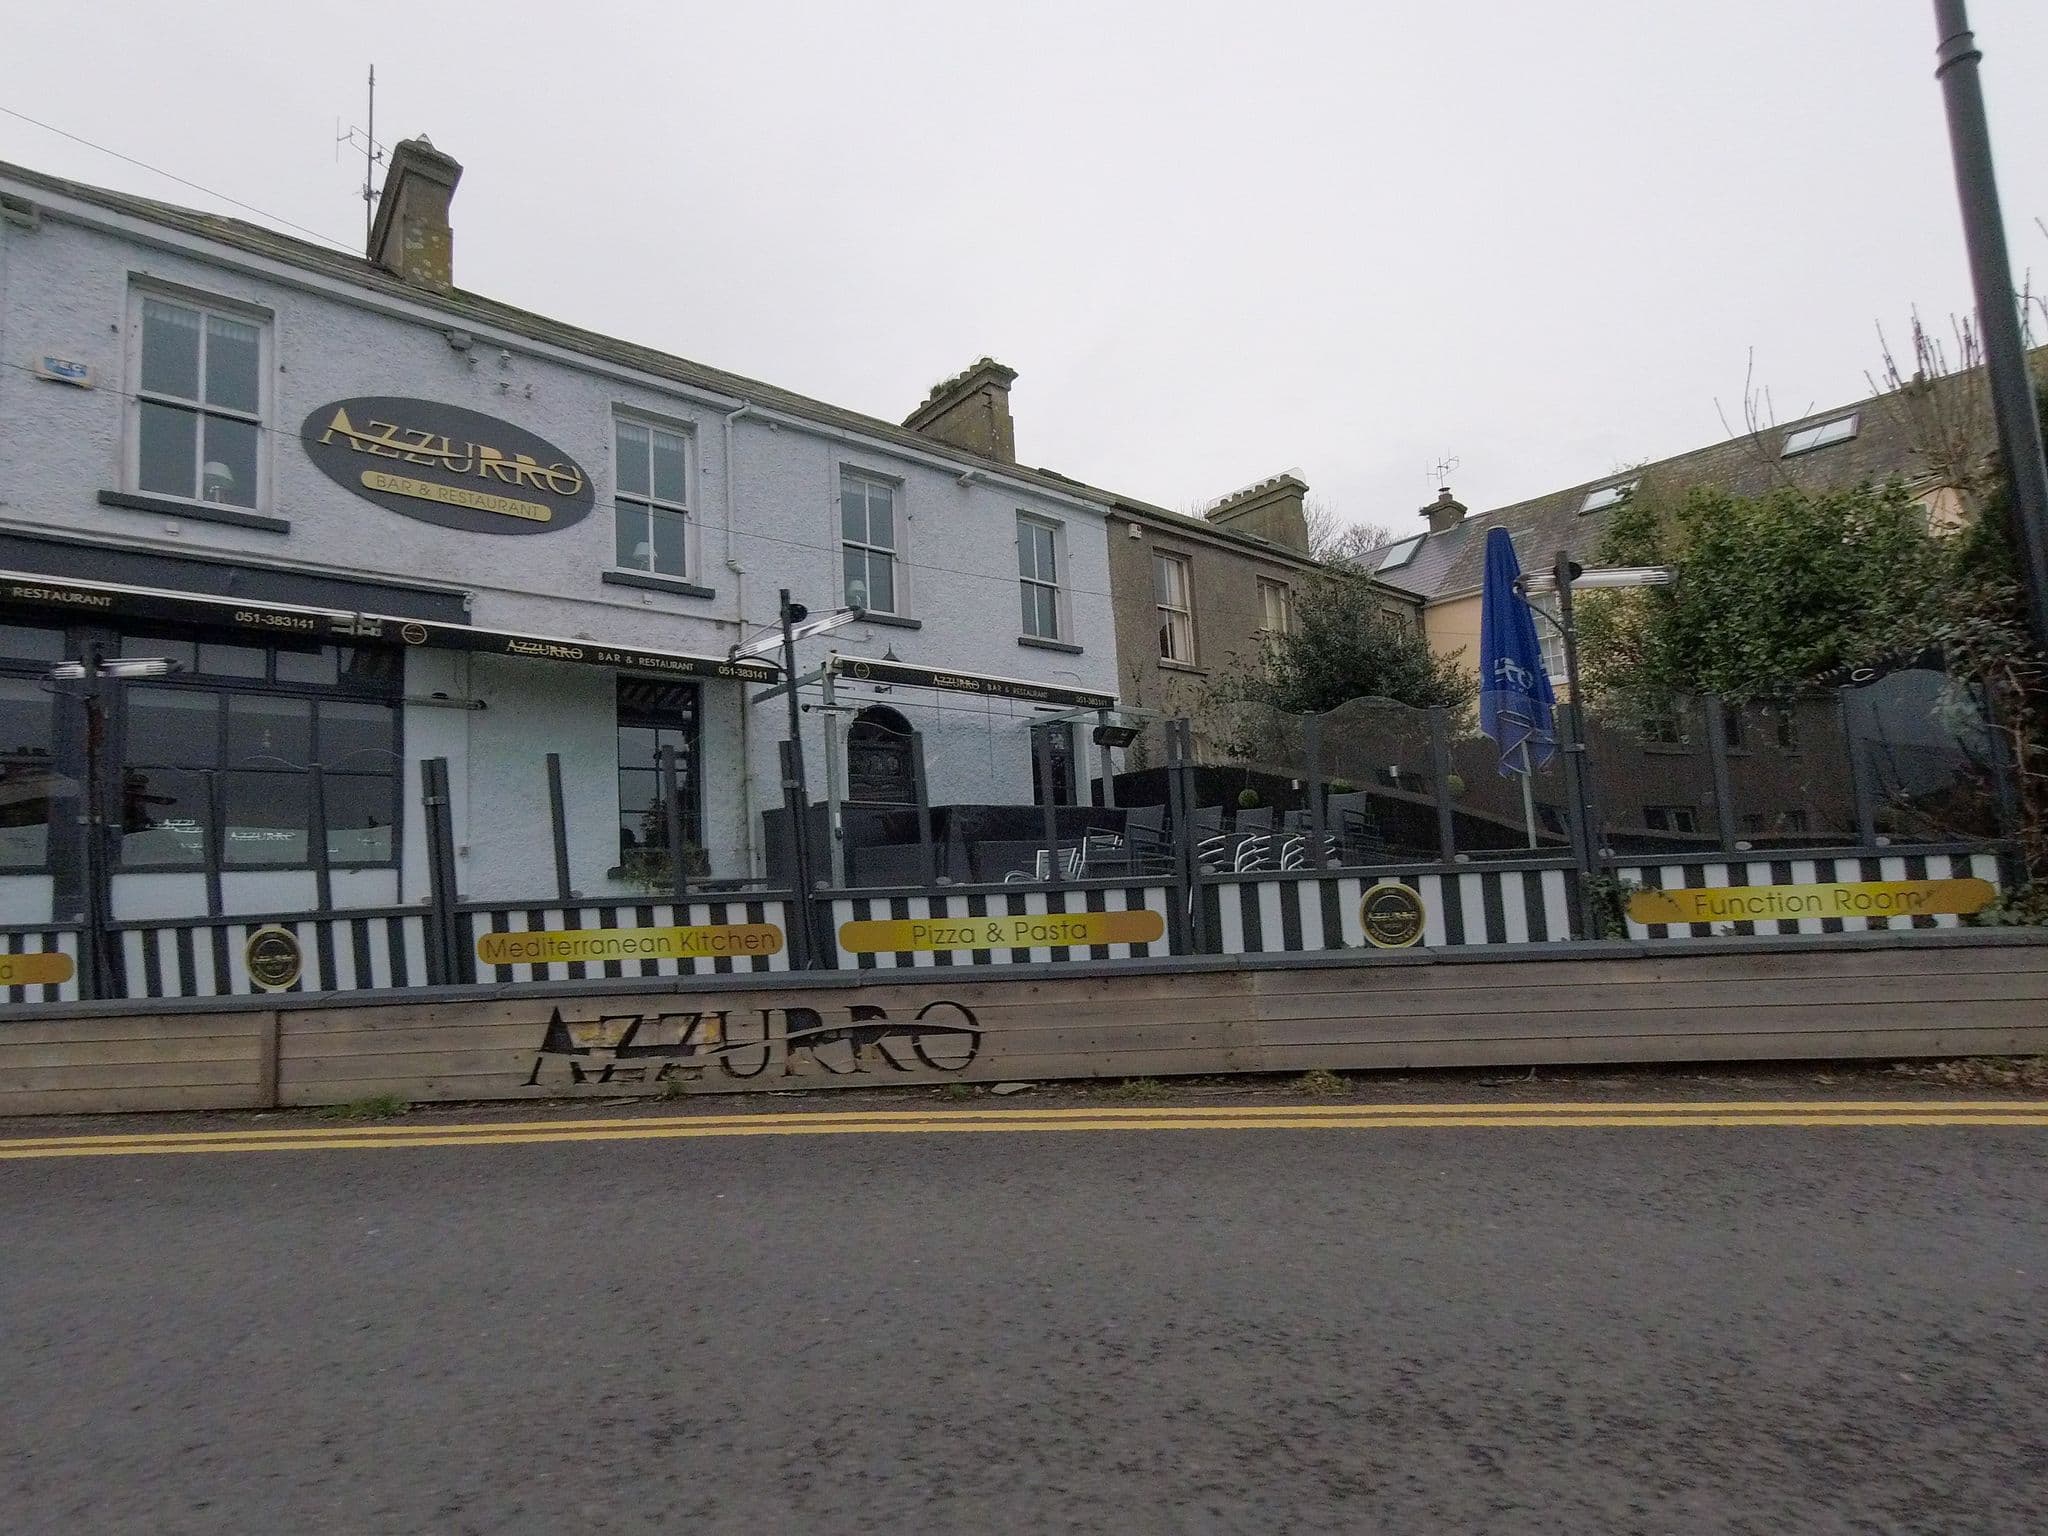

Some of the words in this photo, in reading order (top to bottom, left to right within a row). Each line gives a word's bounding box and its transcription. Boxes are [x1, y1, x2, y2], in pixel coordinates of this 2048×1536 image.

[318, 407, 583, 496] AZZURRO
[376, 474, 412, 494] BAR
[420, 482, 431, 496] &
[438, 487, 540, 517] RESTAURANT
[13, 587, 112, 606] RESTAURANT
[235, 611, 315, 629] 051-383141
[506, 640, 583, 660] AZZURRO
[598, 651, 621, 662] BAR
[626, 655, 633, 664] &
[639, 656, 694, 672] RESTAURANT
[933, 674, 980, 690] AZZURRO
[1695, 891, 1821, 916] Function
[1834, 888, 1922, 912] Room
[486, 935, 671, 959] Mediterranean
[680, 931, 776, 953] Kitchen
[913, 925, 975, 945] Pizza
[986, 922, 1004, 942] &
[1015, 920, 1087, 941] Pasta
[519, 1001, 981, 1087] AZZURRO
